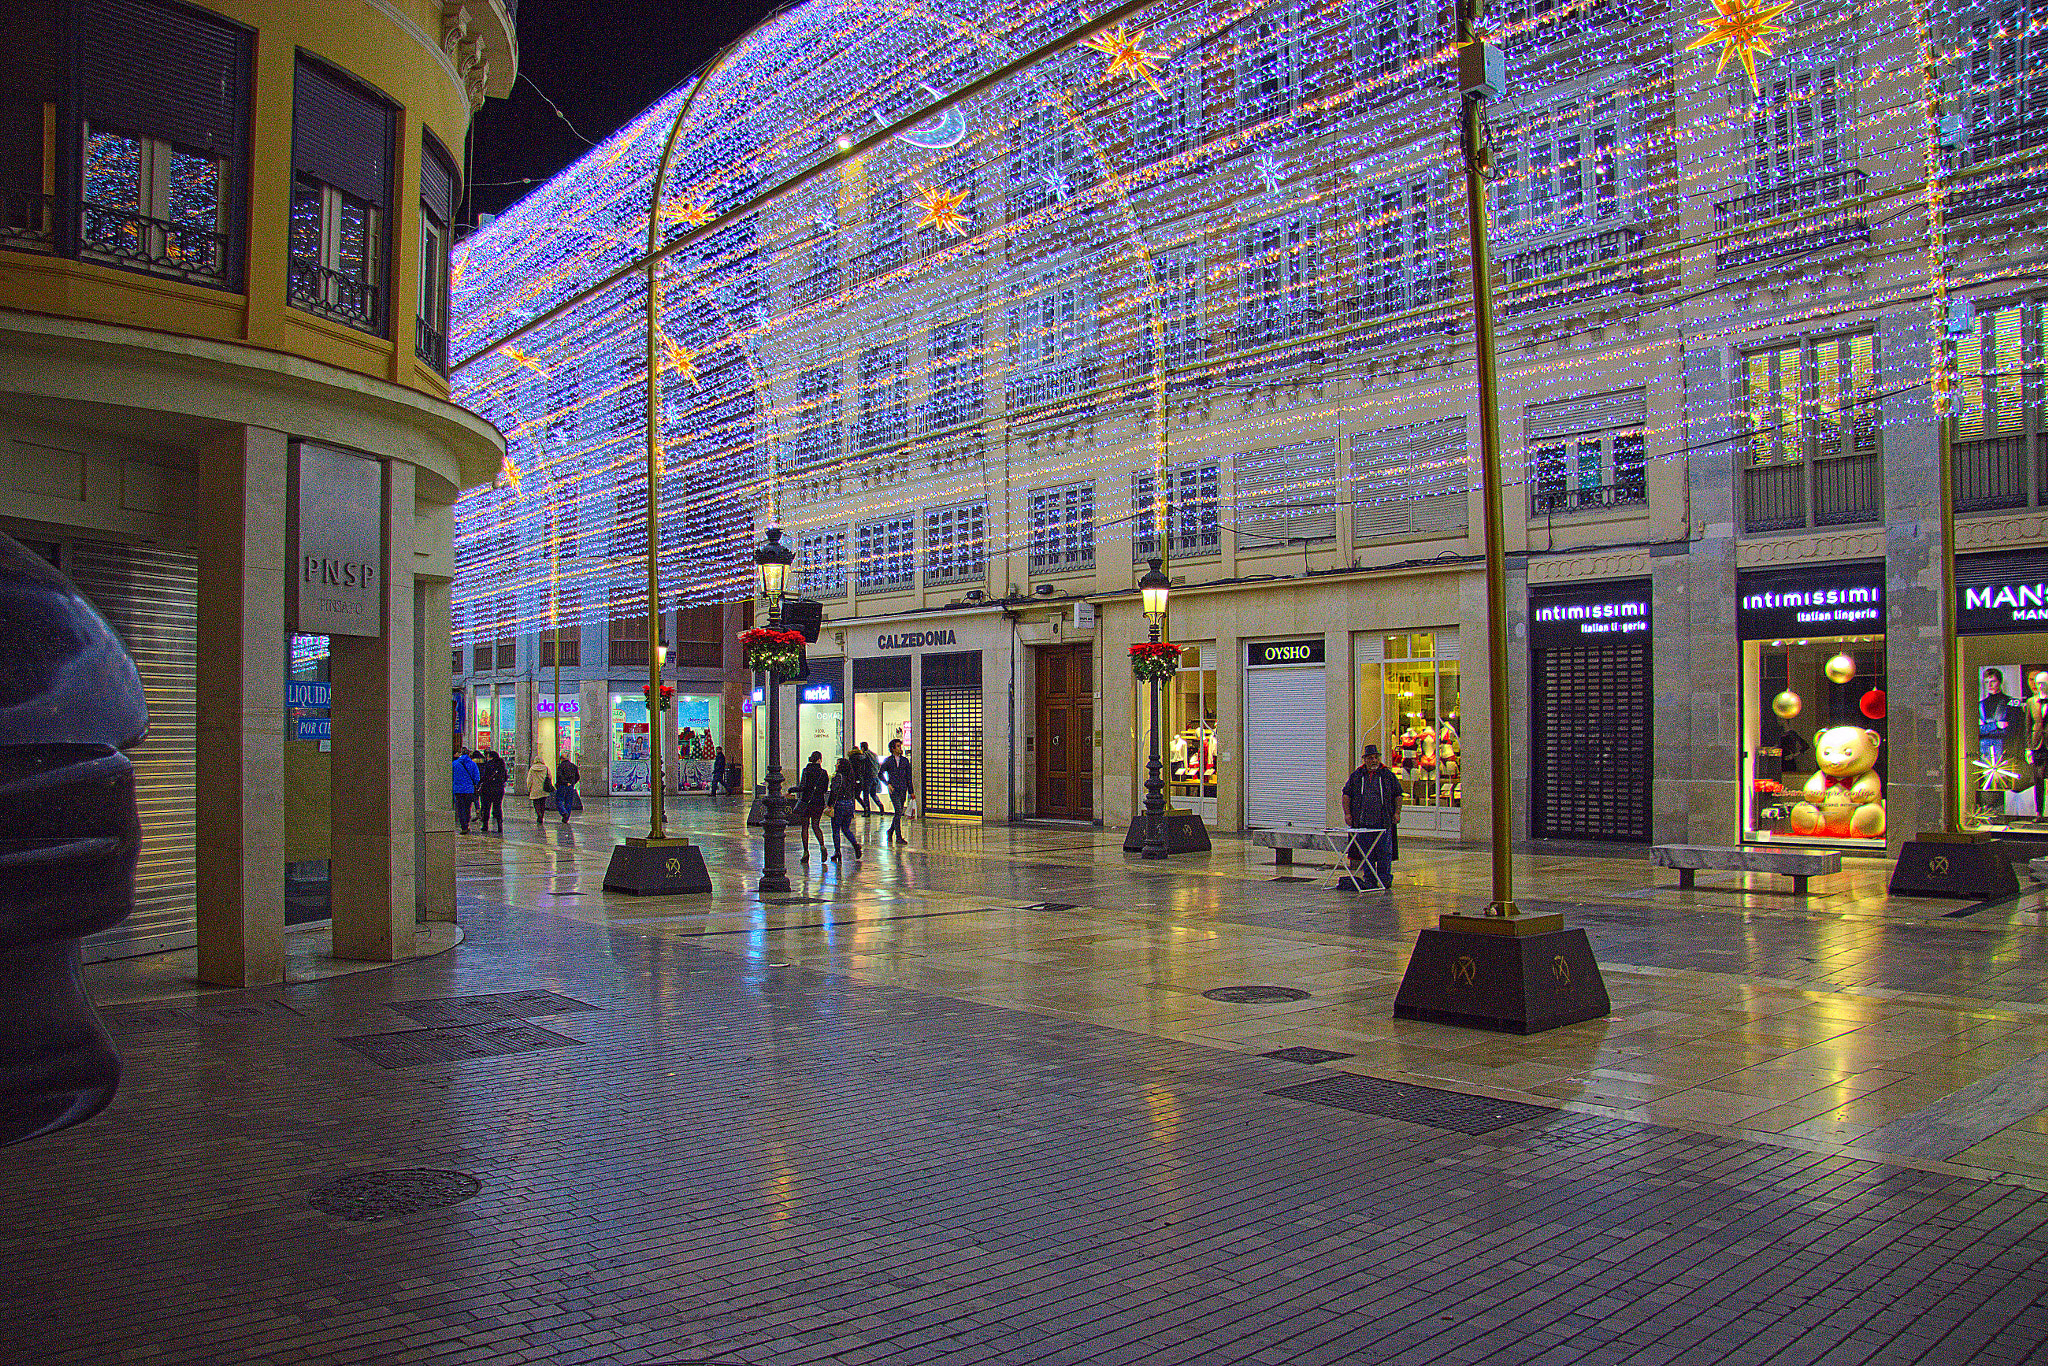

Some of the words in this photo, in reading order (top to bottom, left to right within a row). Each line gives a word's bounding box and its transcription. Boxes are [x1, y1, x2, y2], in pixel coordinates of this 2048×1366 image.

[305, 556, 374, 589] PNSP
[1743, 587, 1880, 610] intimissimi
[1965, 583, 2048, 610] MAN
[1535, 602, 1647, 621] intimissimi
[1833, 608, 1879, 622] lingerie
[1611, 621, 1647, 634] ligerie
[877, 629, 957, 650] CALZEDONIA
[1265, 645, 1311, 660] OYSHO
[537, 699, 579, 713] clare's
[299, 721, 317, 735] POR
